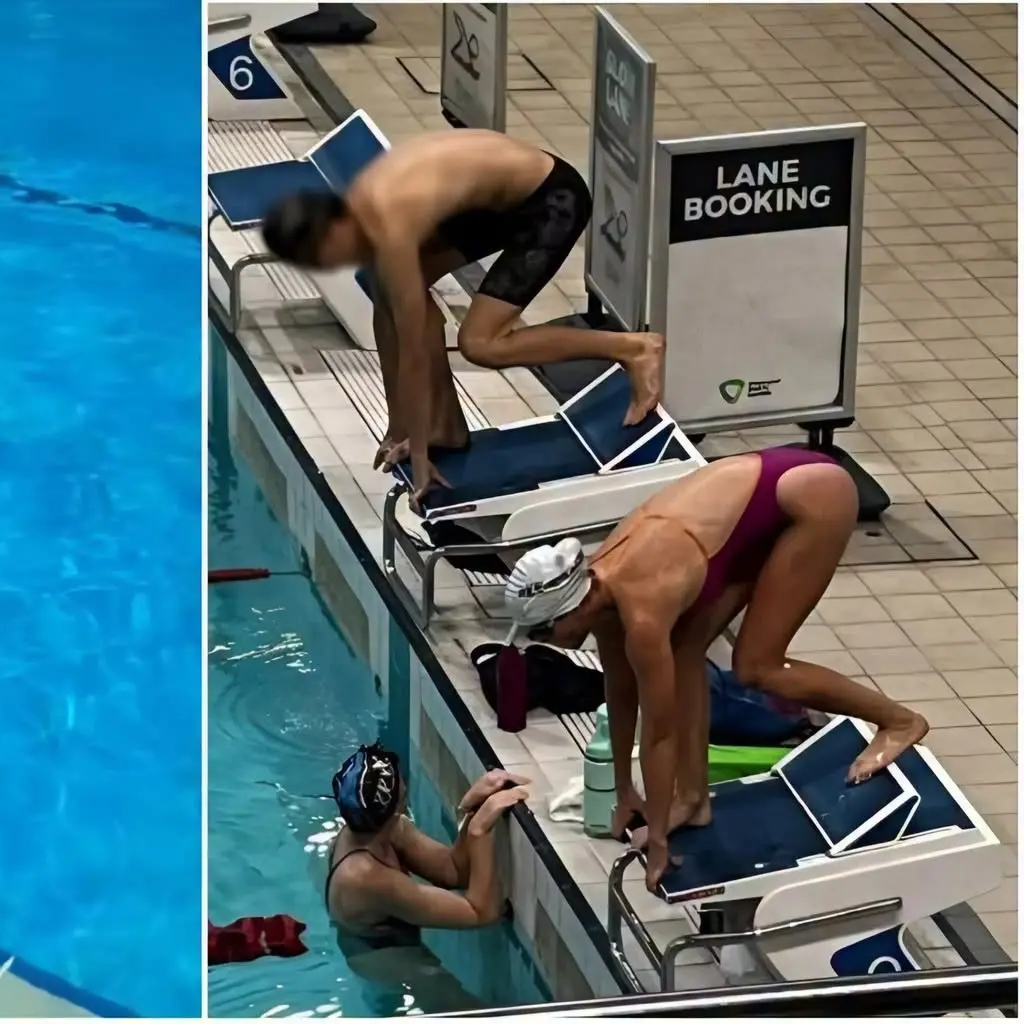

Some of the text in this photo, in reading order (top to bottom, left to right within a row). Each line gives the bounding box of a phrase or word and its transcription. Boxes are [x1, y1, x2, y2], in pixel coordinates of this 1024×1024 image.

[228, 54, 255, 91] 6
[716, 159, 801, 190] LANE
[684, 185, 831, 222] BOOKING
